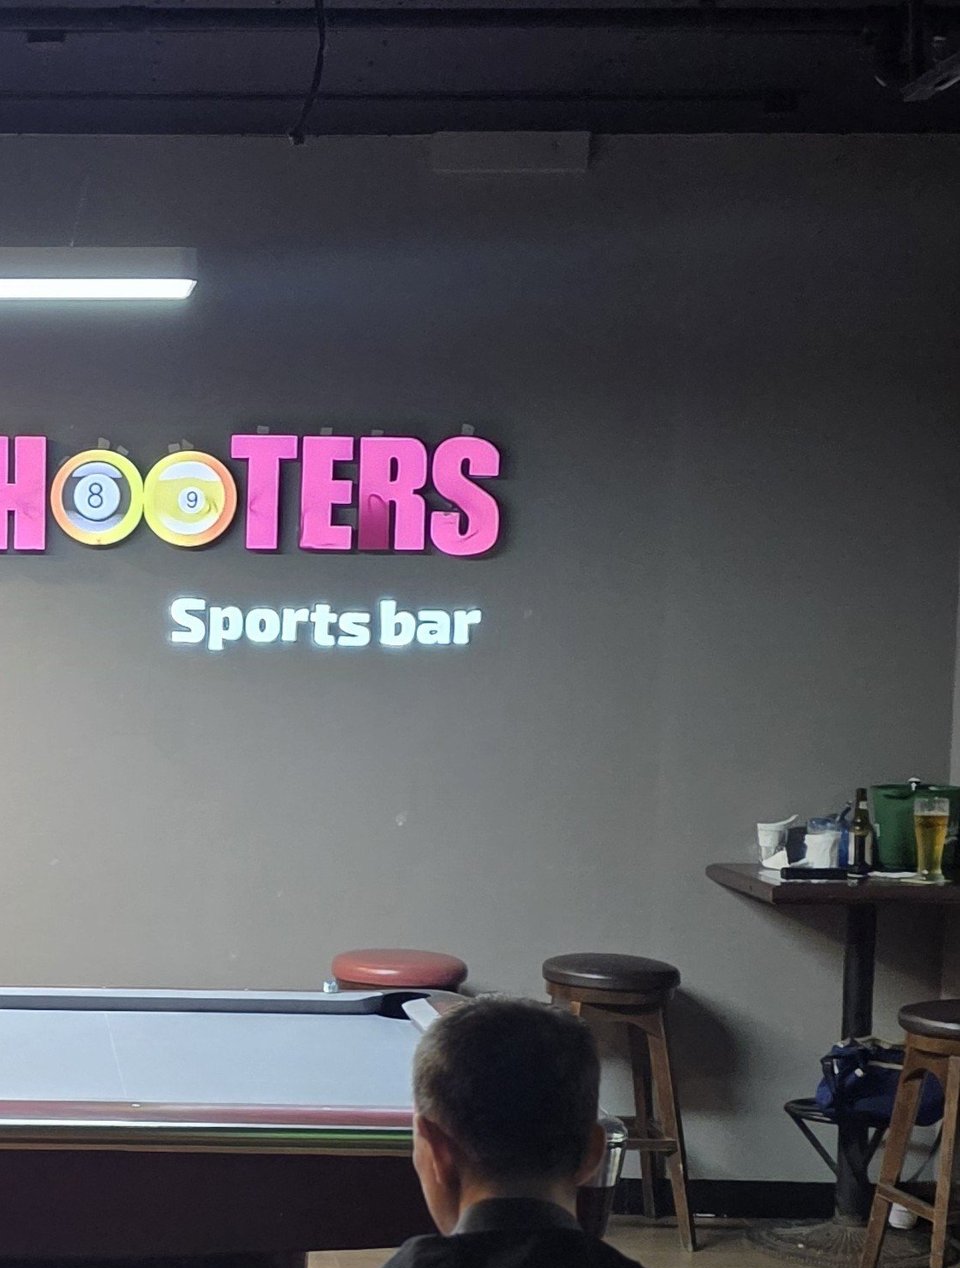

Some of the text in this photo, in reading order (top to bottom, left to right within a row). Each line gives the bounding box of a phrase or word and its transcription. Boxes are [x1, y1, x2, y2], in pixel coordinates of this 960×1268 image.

[87, 482, 104, 509] 8
[186, 491, 199, 509] 9
[169, 597, 482, 651] Sports bar
